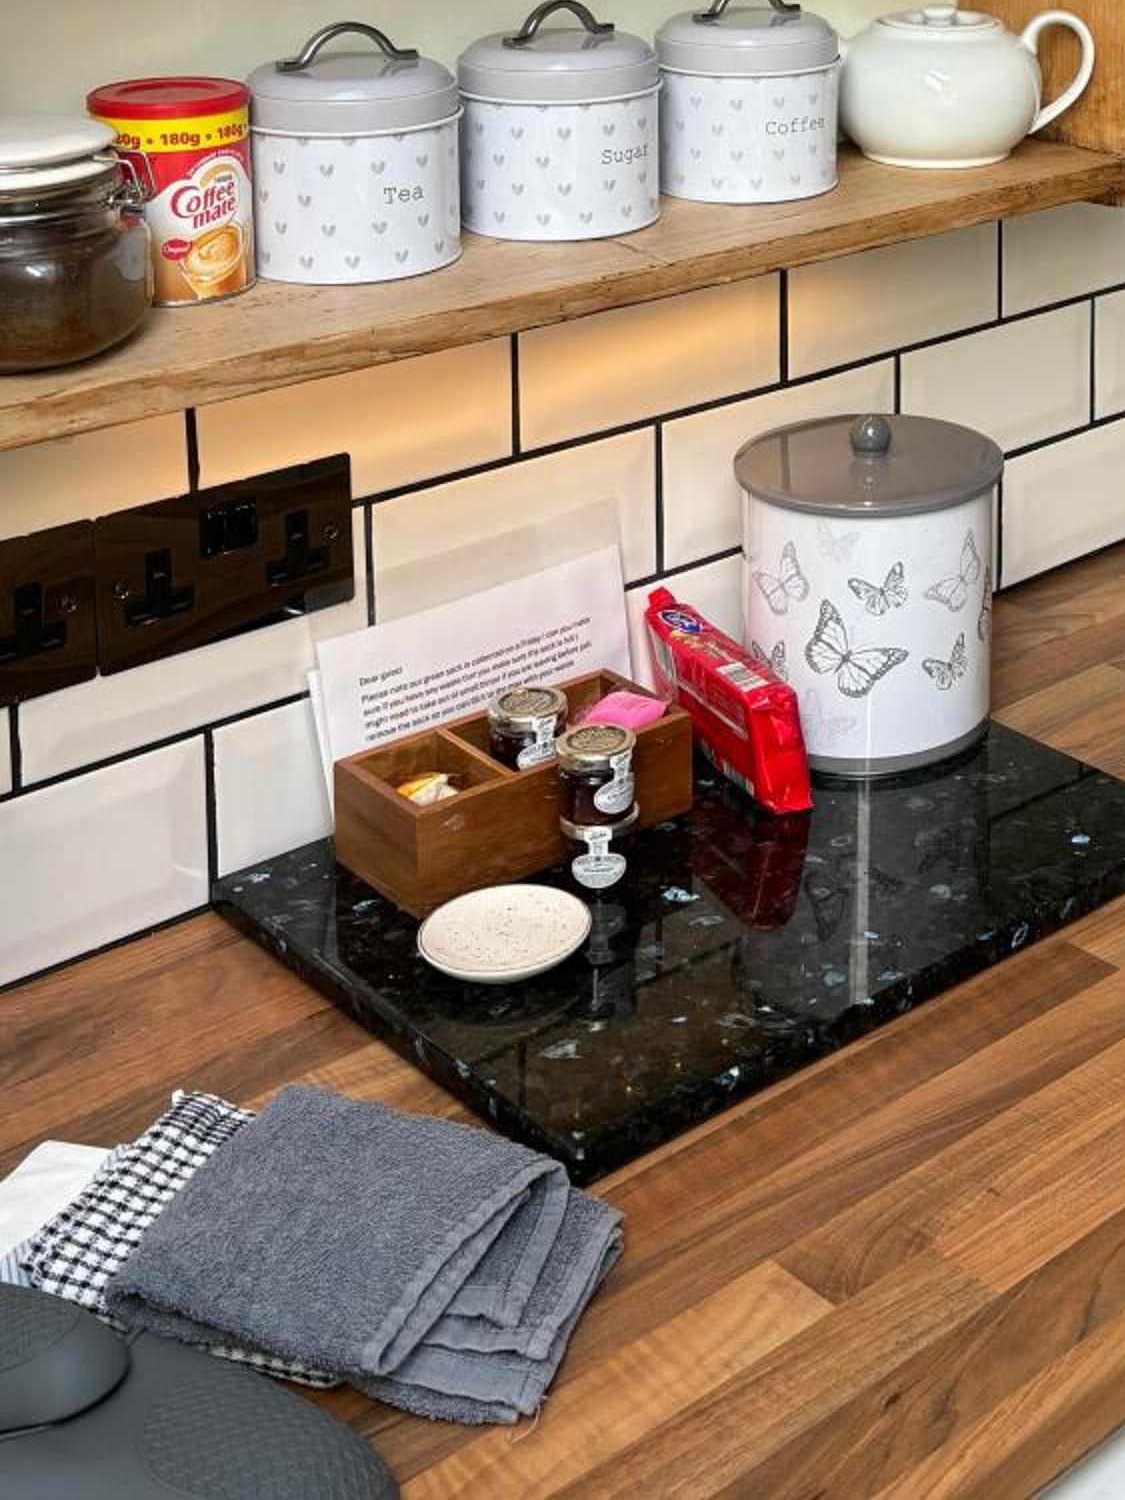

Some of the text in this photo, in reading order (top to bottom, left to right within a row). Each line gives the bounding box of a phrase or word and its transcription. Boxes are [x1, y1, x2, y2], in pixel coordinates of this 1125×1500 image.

[764, 115, 827, 136] Coffee
[159, 131, 201, 147] 180g
[600, 142, 649, 166] Sugar
[170, 181, 236, 219] Coffee
[383, 186, 424, 205] Tea
[192, 196, 237, 229] mate
